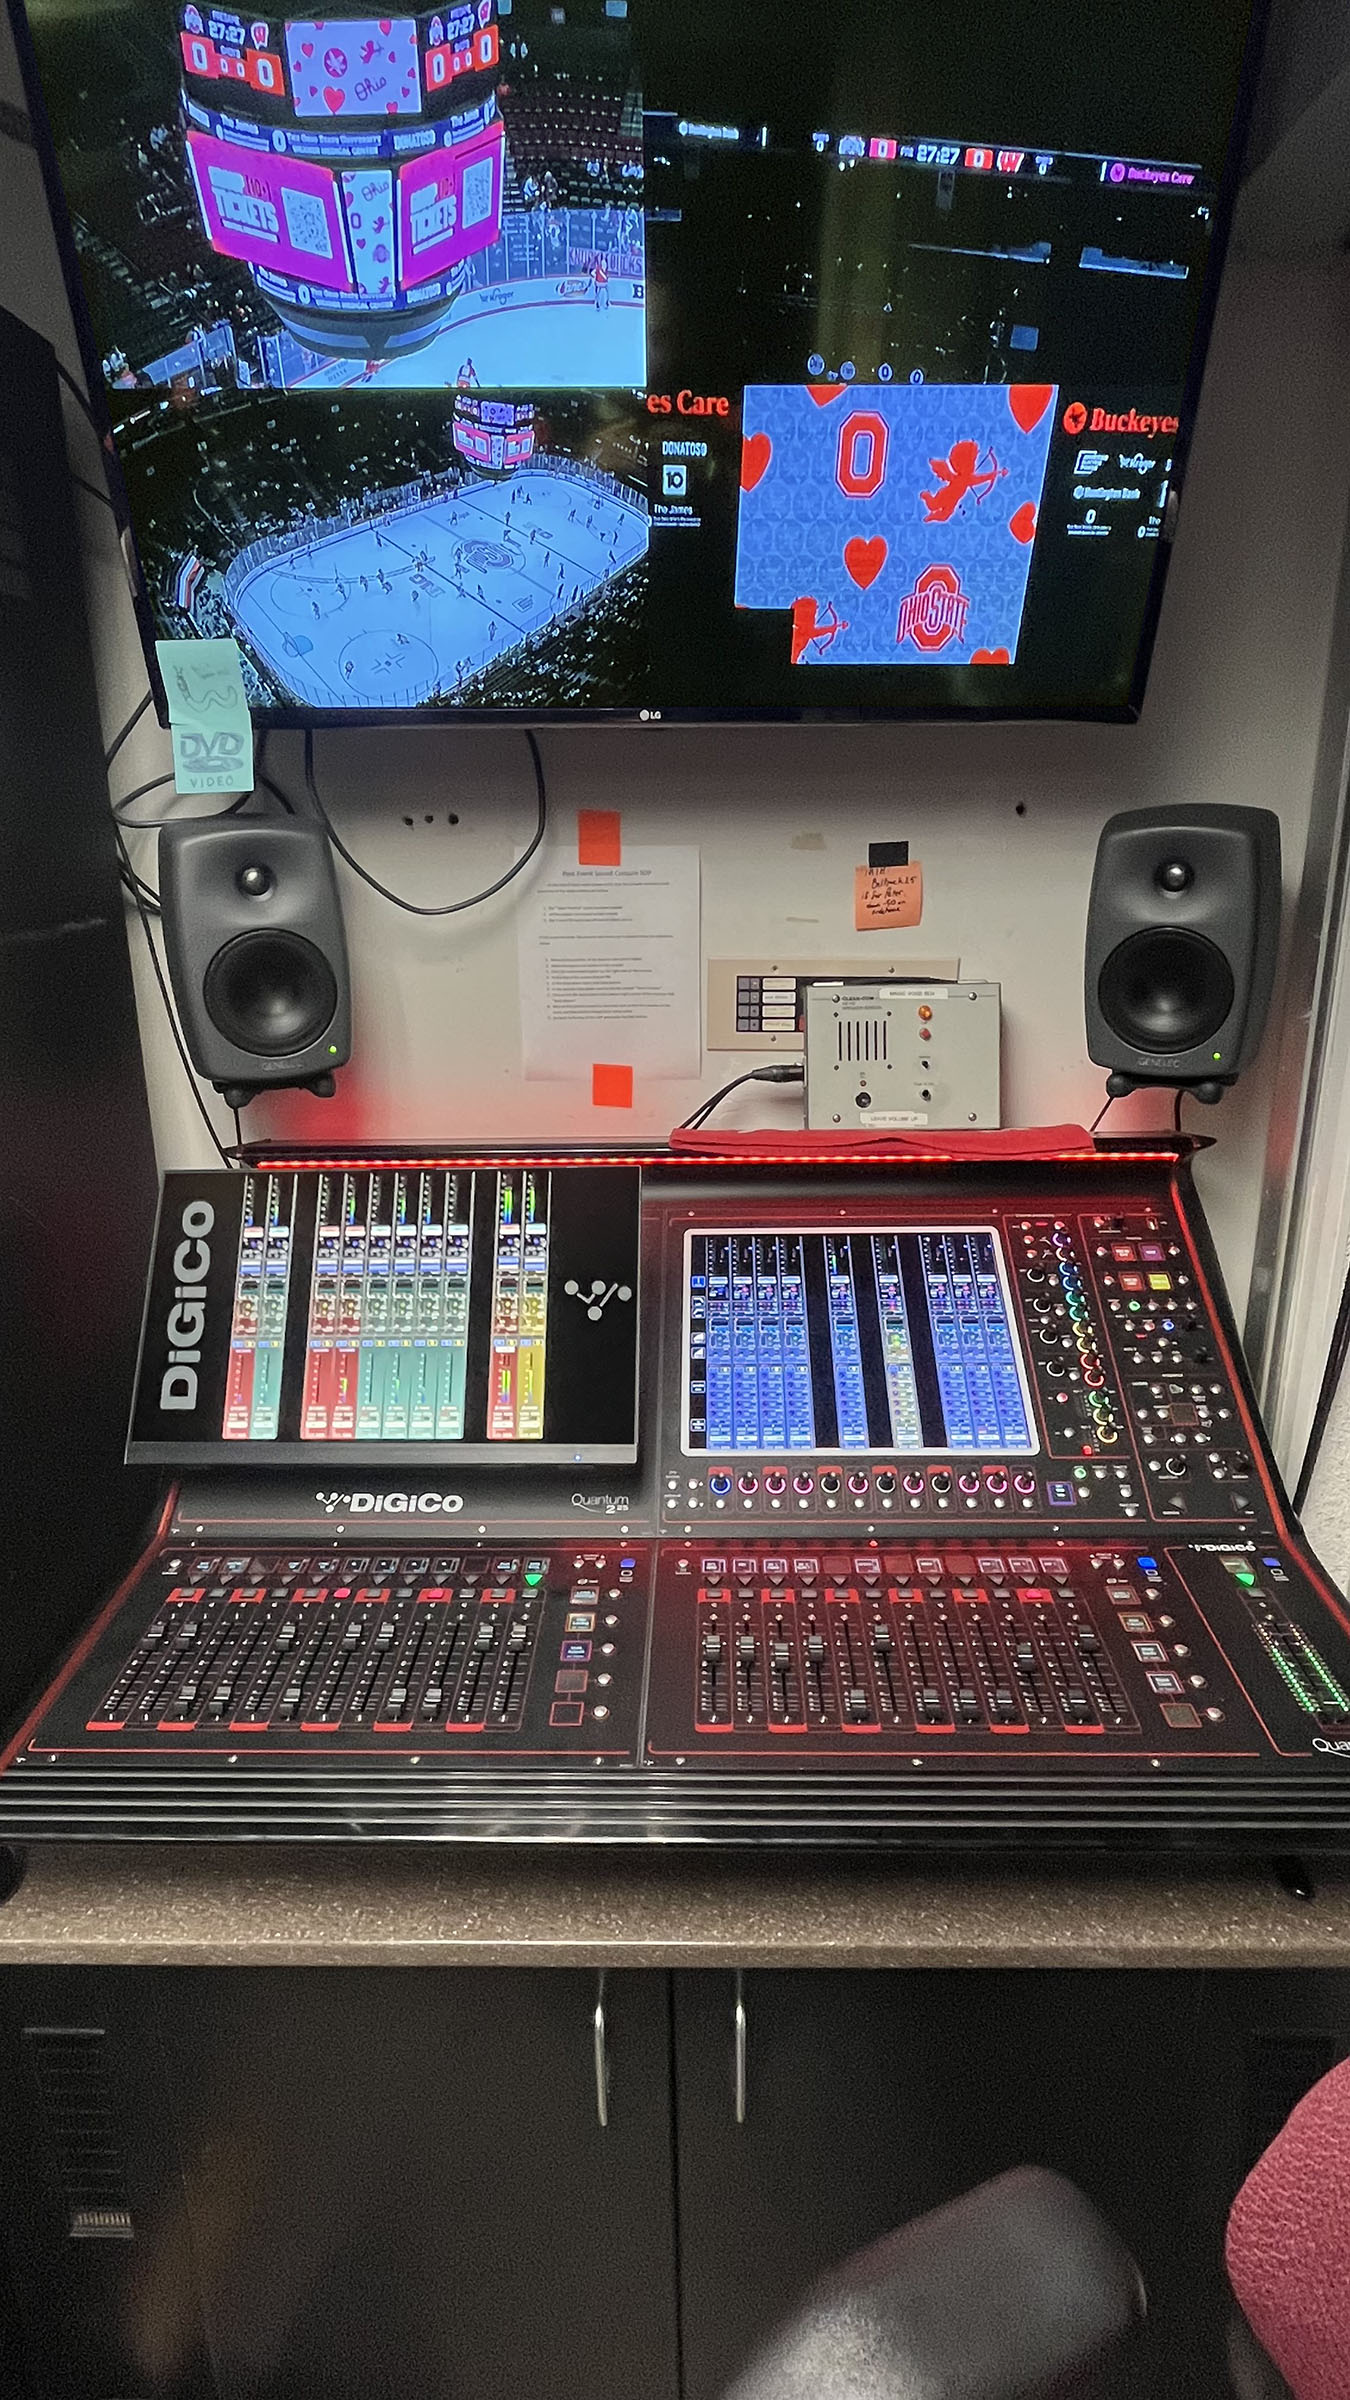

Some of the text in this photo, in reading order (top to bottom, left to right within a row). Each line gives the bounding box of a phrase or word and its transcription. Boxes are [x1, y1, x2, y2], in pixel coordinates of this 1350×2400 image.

[208, 20, 246, 46] 27:27
[447, 13, 475, 41] 27:27
[191, 41, 208, 72] 0
[481, 34, 493, 64] 0
[257, 58, 275, 88] 0
[433, 53, 445, 83] 0
[354, 76, 388, 101] Ohio
[916, 144, 961, 166] 27:27
[361, 182, 390, 202] Ohio
[677, 389, 729, 417] Care
[666, 471, 684, 489] 10
[650, 710, 661, 720] LG
[180, 731, 244, 758] DVD
[190, 775, 234, 789] VIDEO
[160, 1200, 215, 1410] DiGiCo
[350, 1493, 464, 1513] DiGiCo
[571, 1493, 629, 1513] Quantum
